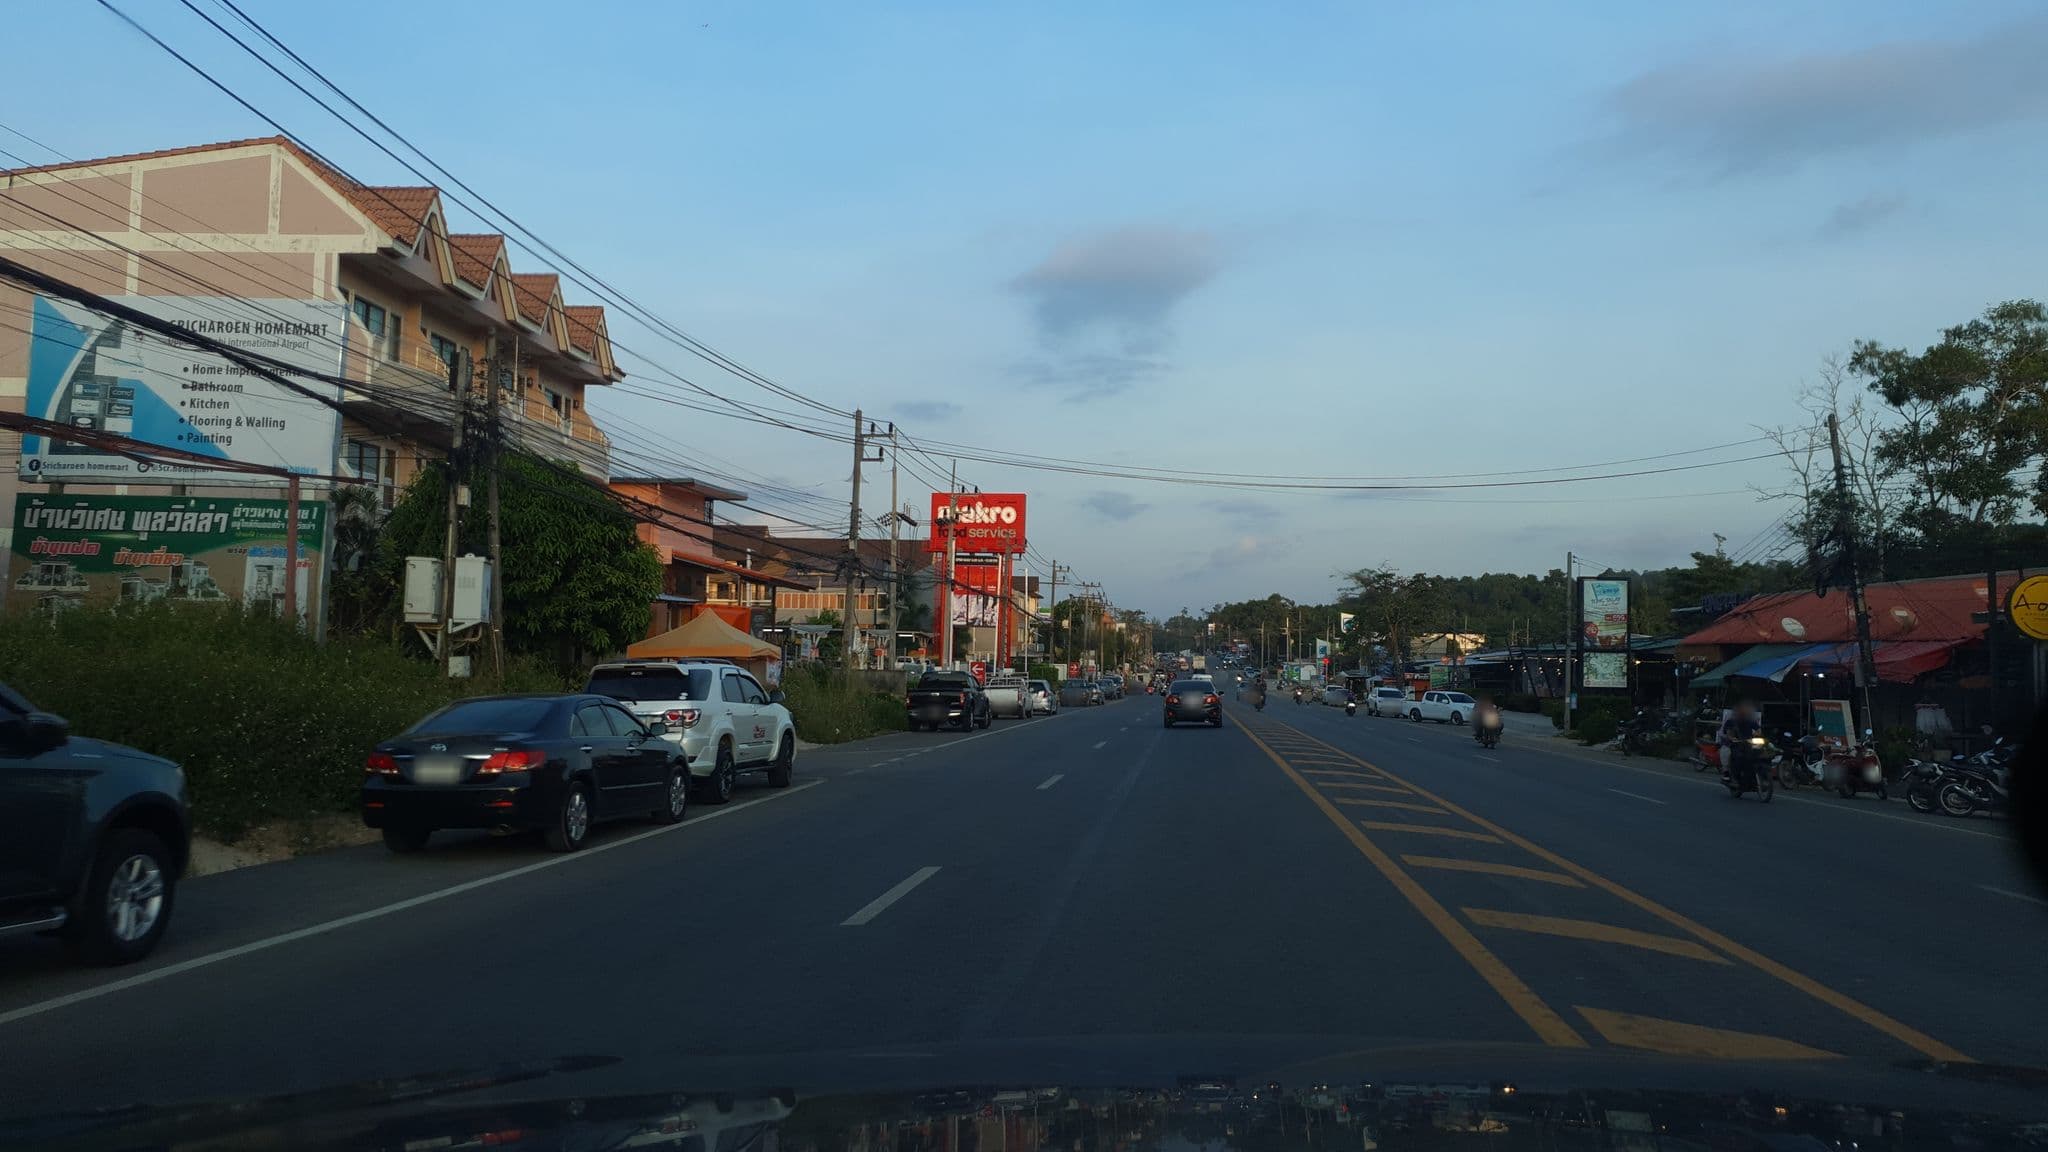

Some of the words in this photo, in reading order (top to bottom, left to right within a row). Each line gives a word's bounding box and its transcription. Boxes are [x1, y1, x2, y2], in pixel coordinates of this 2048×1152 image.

[254, 321, 328, 336] HOMEMART
[192, 364, 223, 375] Home
[191, 381, 243, 393] Bathroom
[190, 398, 230, 409] Kitchen
[188, 416, 232, 429] Flooring
[235, 416, 243, 427] &
[246, 416, 286, 430] Walling
[187, 433, 233, 446] Painting
[87, 461, 129, 471] homemart
[23, 499, 126, 531] บ้านวิเศษ
[131, 504, 230, 541] พูลวิลล่า
[968, 527, 1016, 538] service
